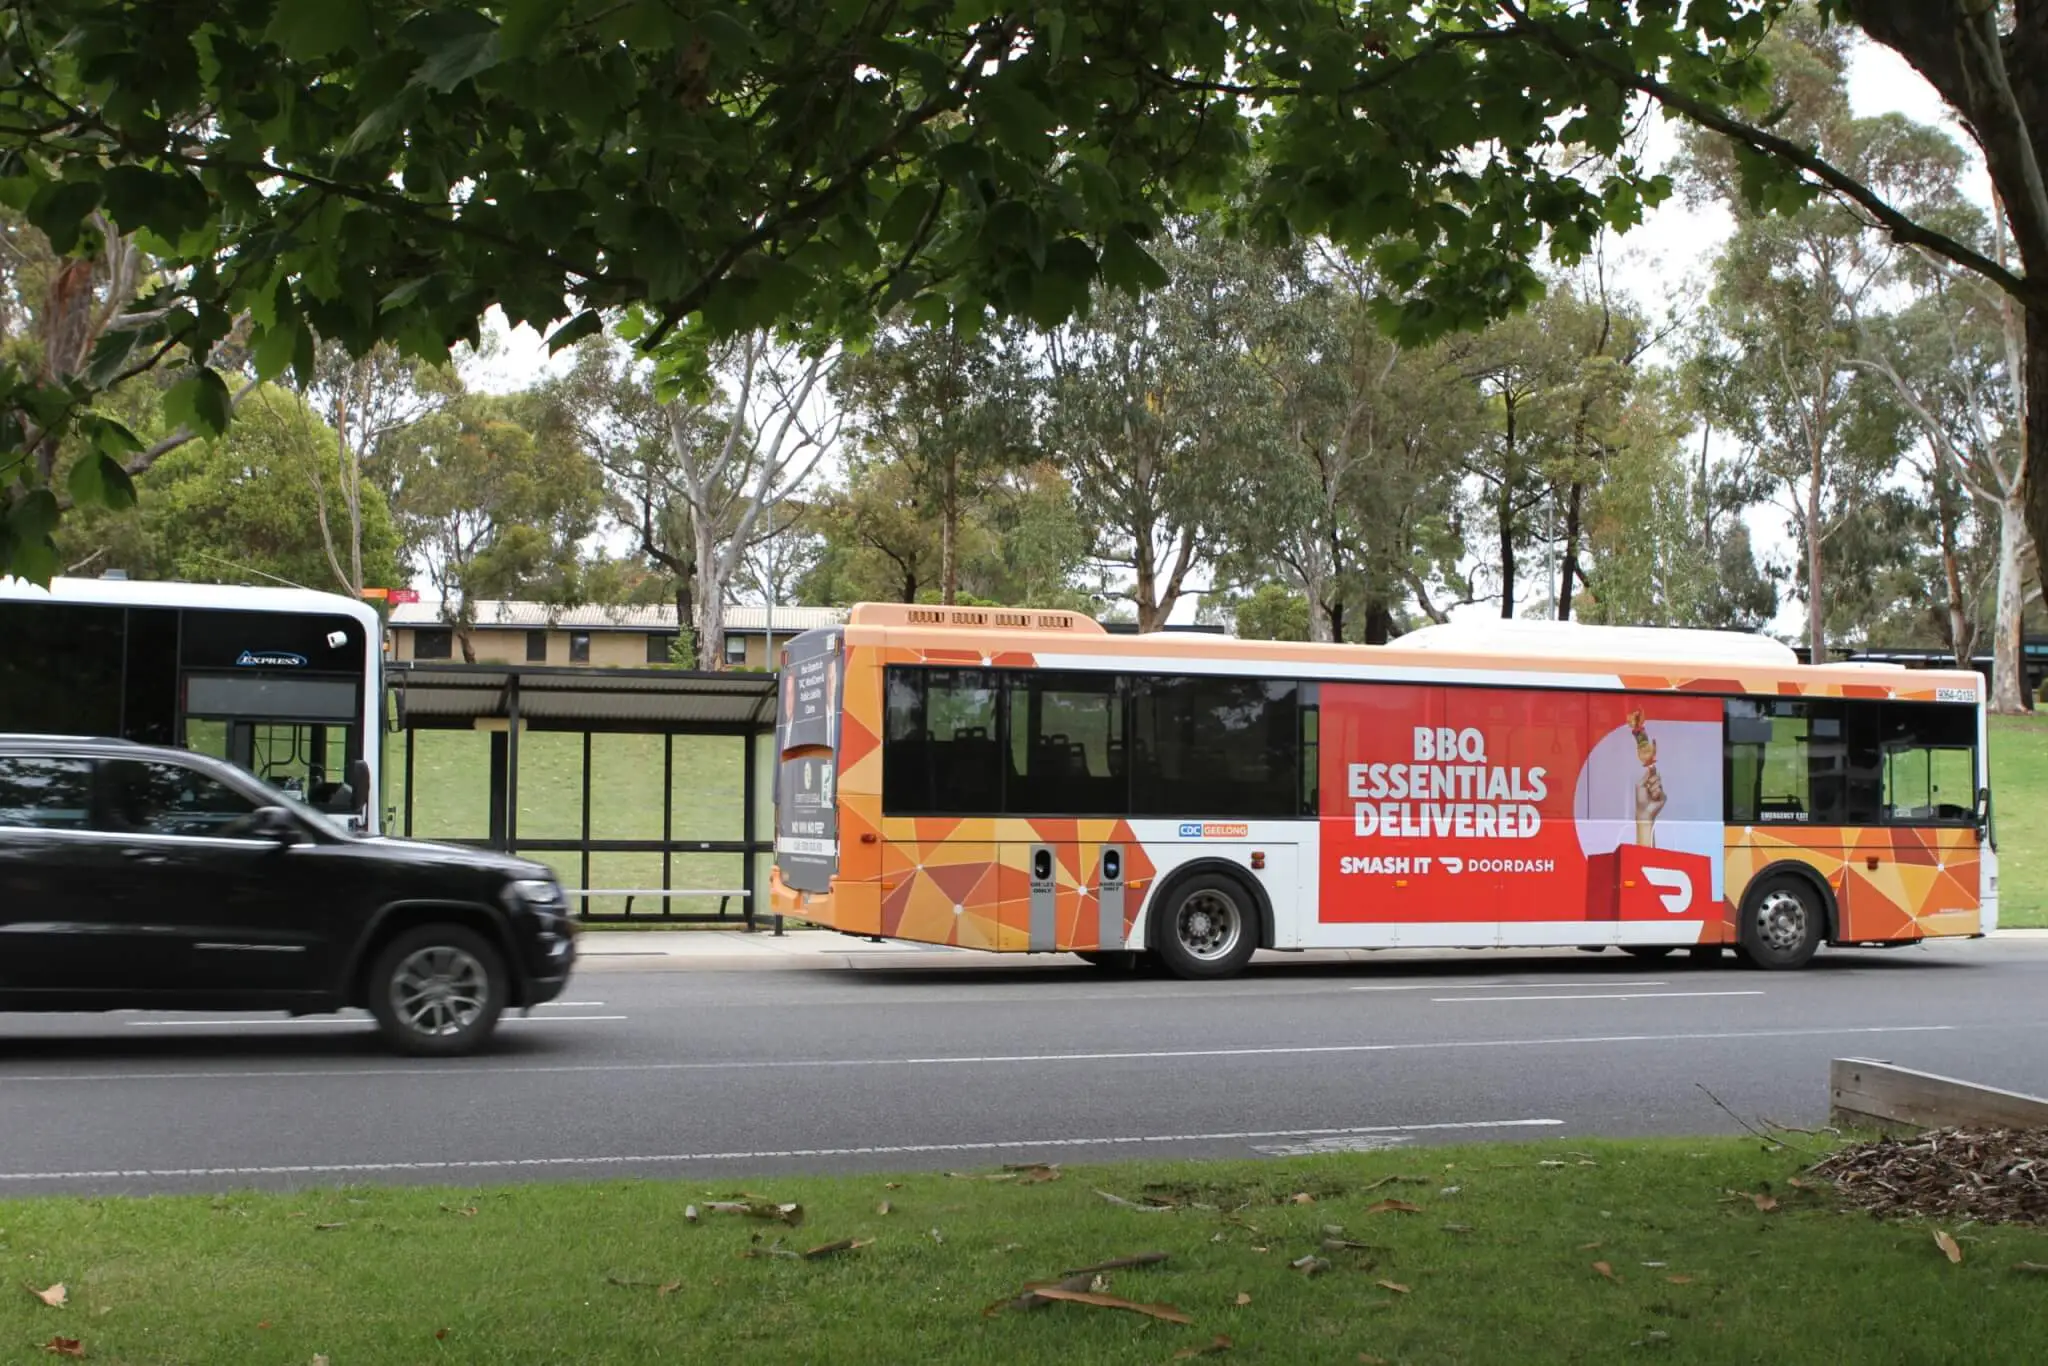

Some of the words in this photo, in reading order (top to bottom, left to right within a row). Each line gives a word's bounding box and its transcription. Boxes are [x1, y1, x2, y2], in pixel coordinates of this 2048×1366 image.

[242, 655, 300, 665] EXPRESS
[1413, 726, 1487, 763] BBQ
[1347, 763, 1548, 801] ESSENTIALS
[1180, 825, 1201, 835] CDC
[1204, 825, 1247, 836] GEELONG
[1354, 802, 1542, 838] DELIVERED
[1339, 856, 1410, 875] SMASH
[1413, 857, 1432, 874] IT
[1468, 858, 1555, 873] DOORDASH
